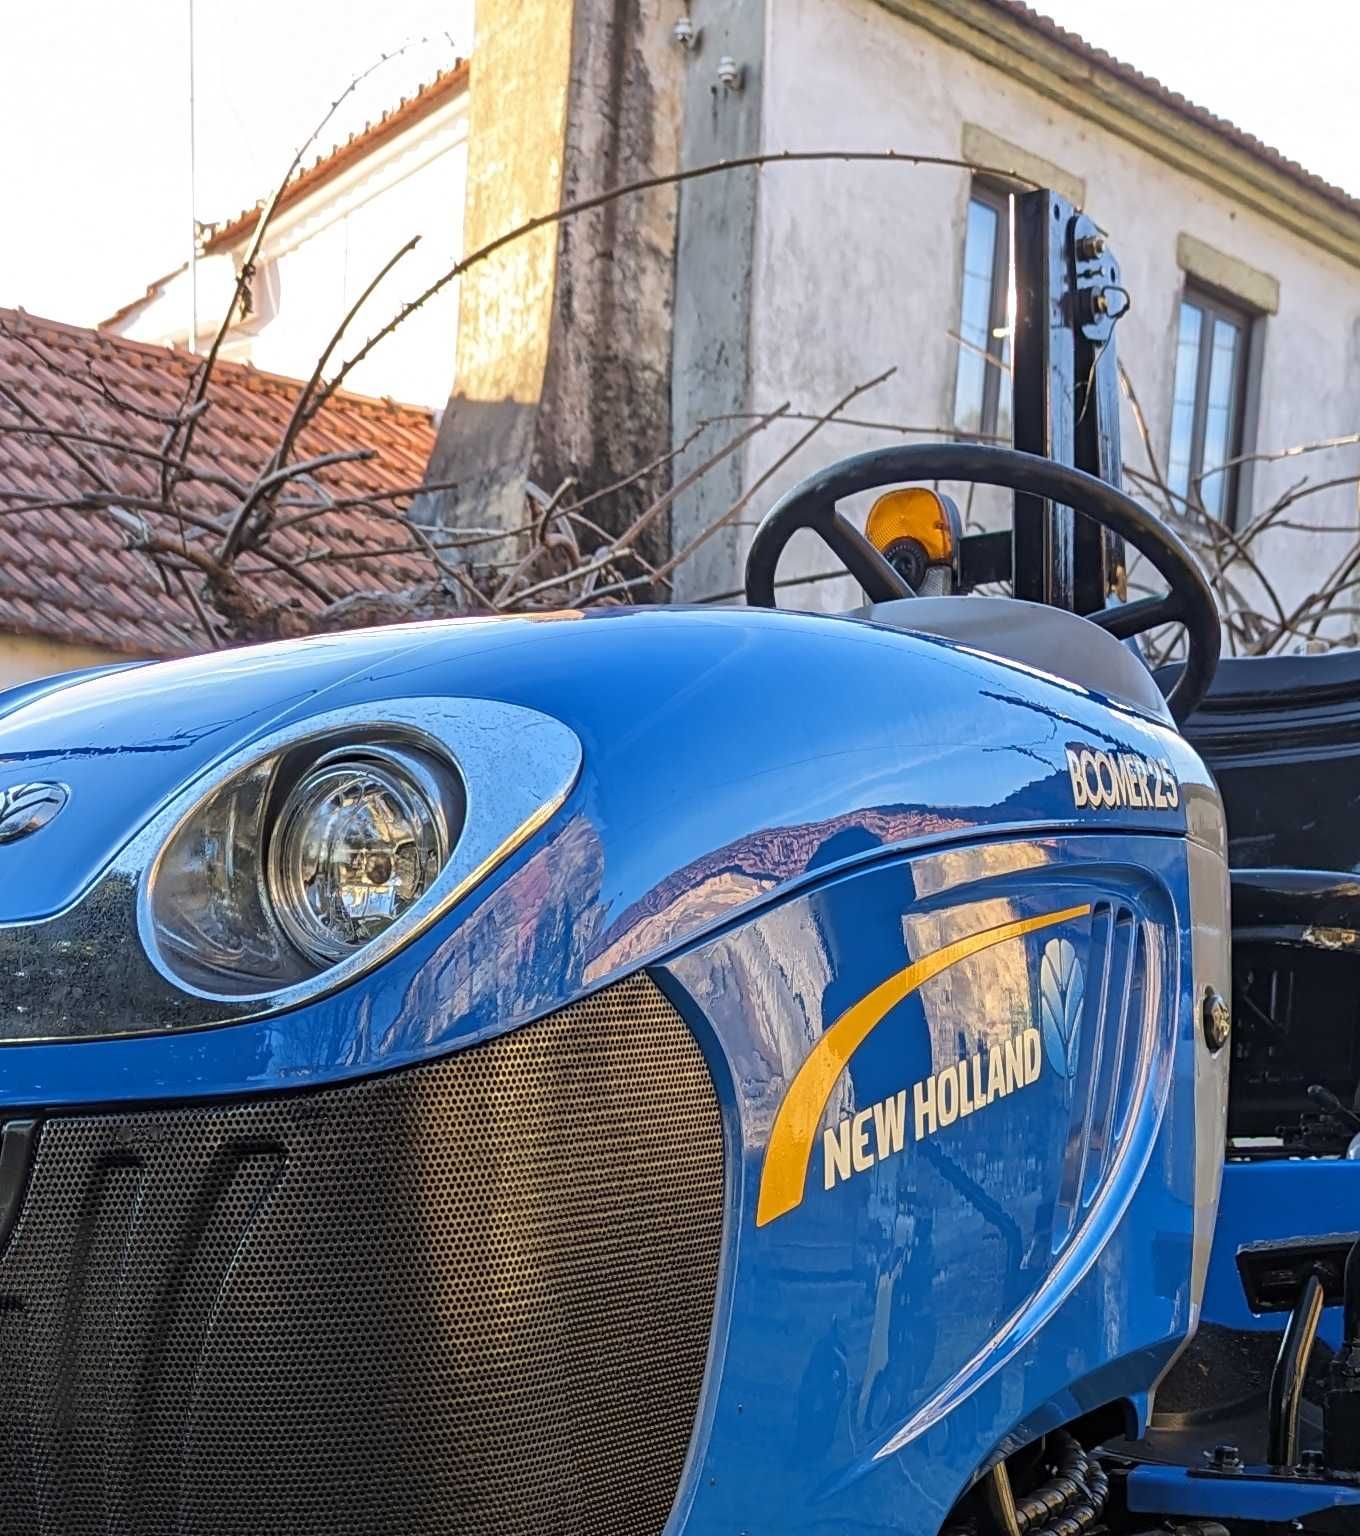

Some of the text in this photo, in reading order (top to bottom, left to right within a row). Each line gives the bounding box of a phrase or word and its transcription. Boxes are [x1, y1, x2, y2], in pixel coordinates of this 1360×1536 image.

[1065, 747, 1179, 810] BOOMER 25
[823, 1027, 1043, 1191] NEW HOLLAND
